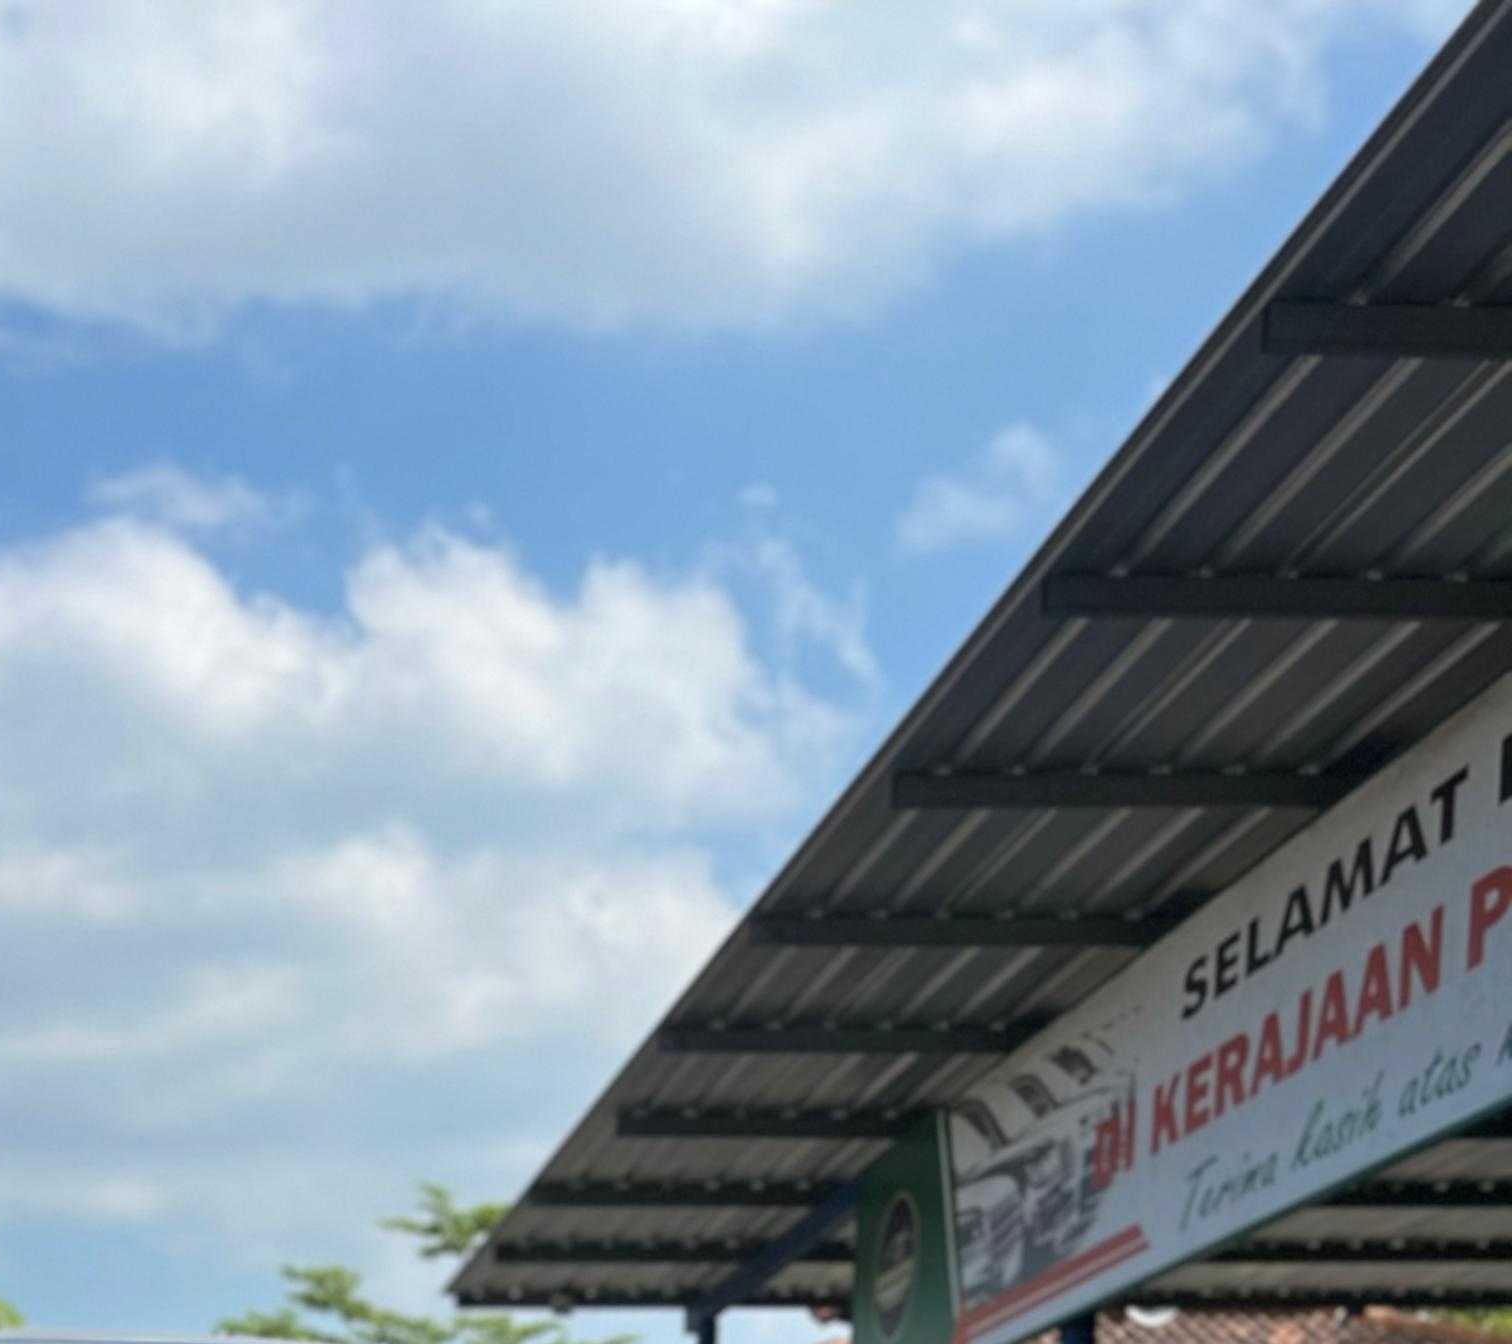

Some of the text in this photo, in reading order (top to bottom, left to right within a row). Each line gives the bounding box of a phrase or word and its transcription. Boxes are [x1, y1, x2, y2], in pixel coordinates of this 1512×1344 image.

[1181, 764, 1469, 1021] SELAMAT
[1150, 903, 1445, 1156] KERAJAAN
[1397, 1042, 1482, 1119] atas
